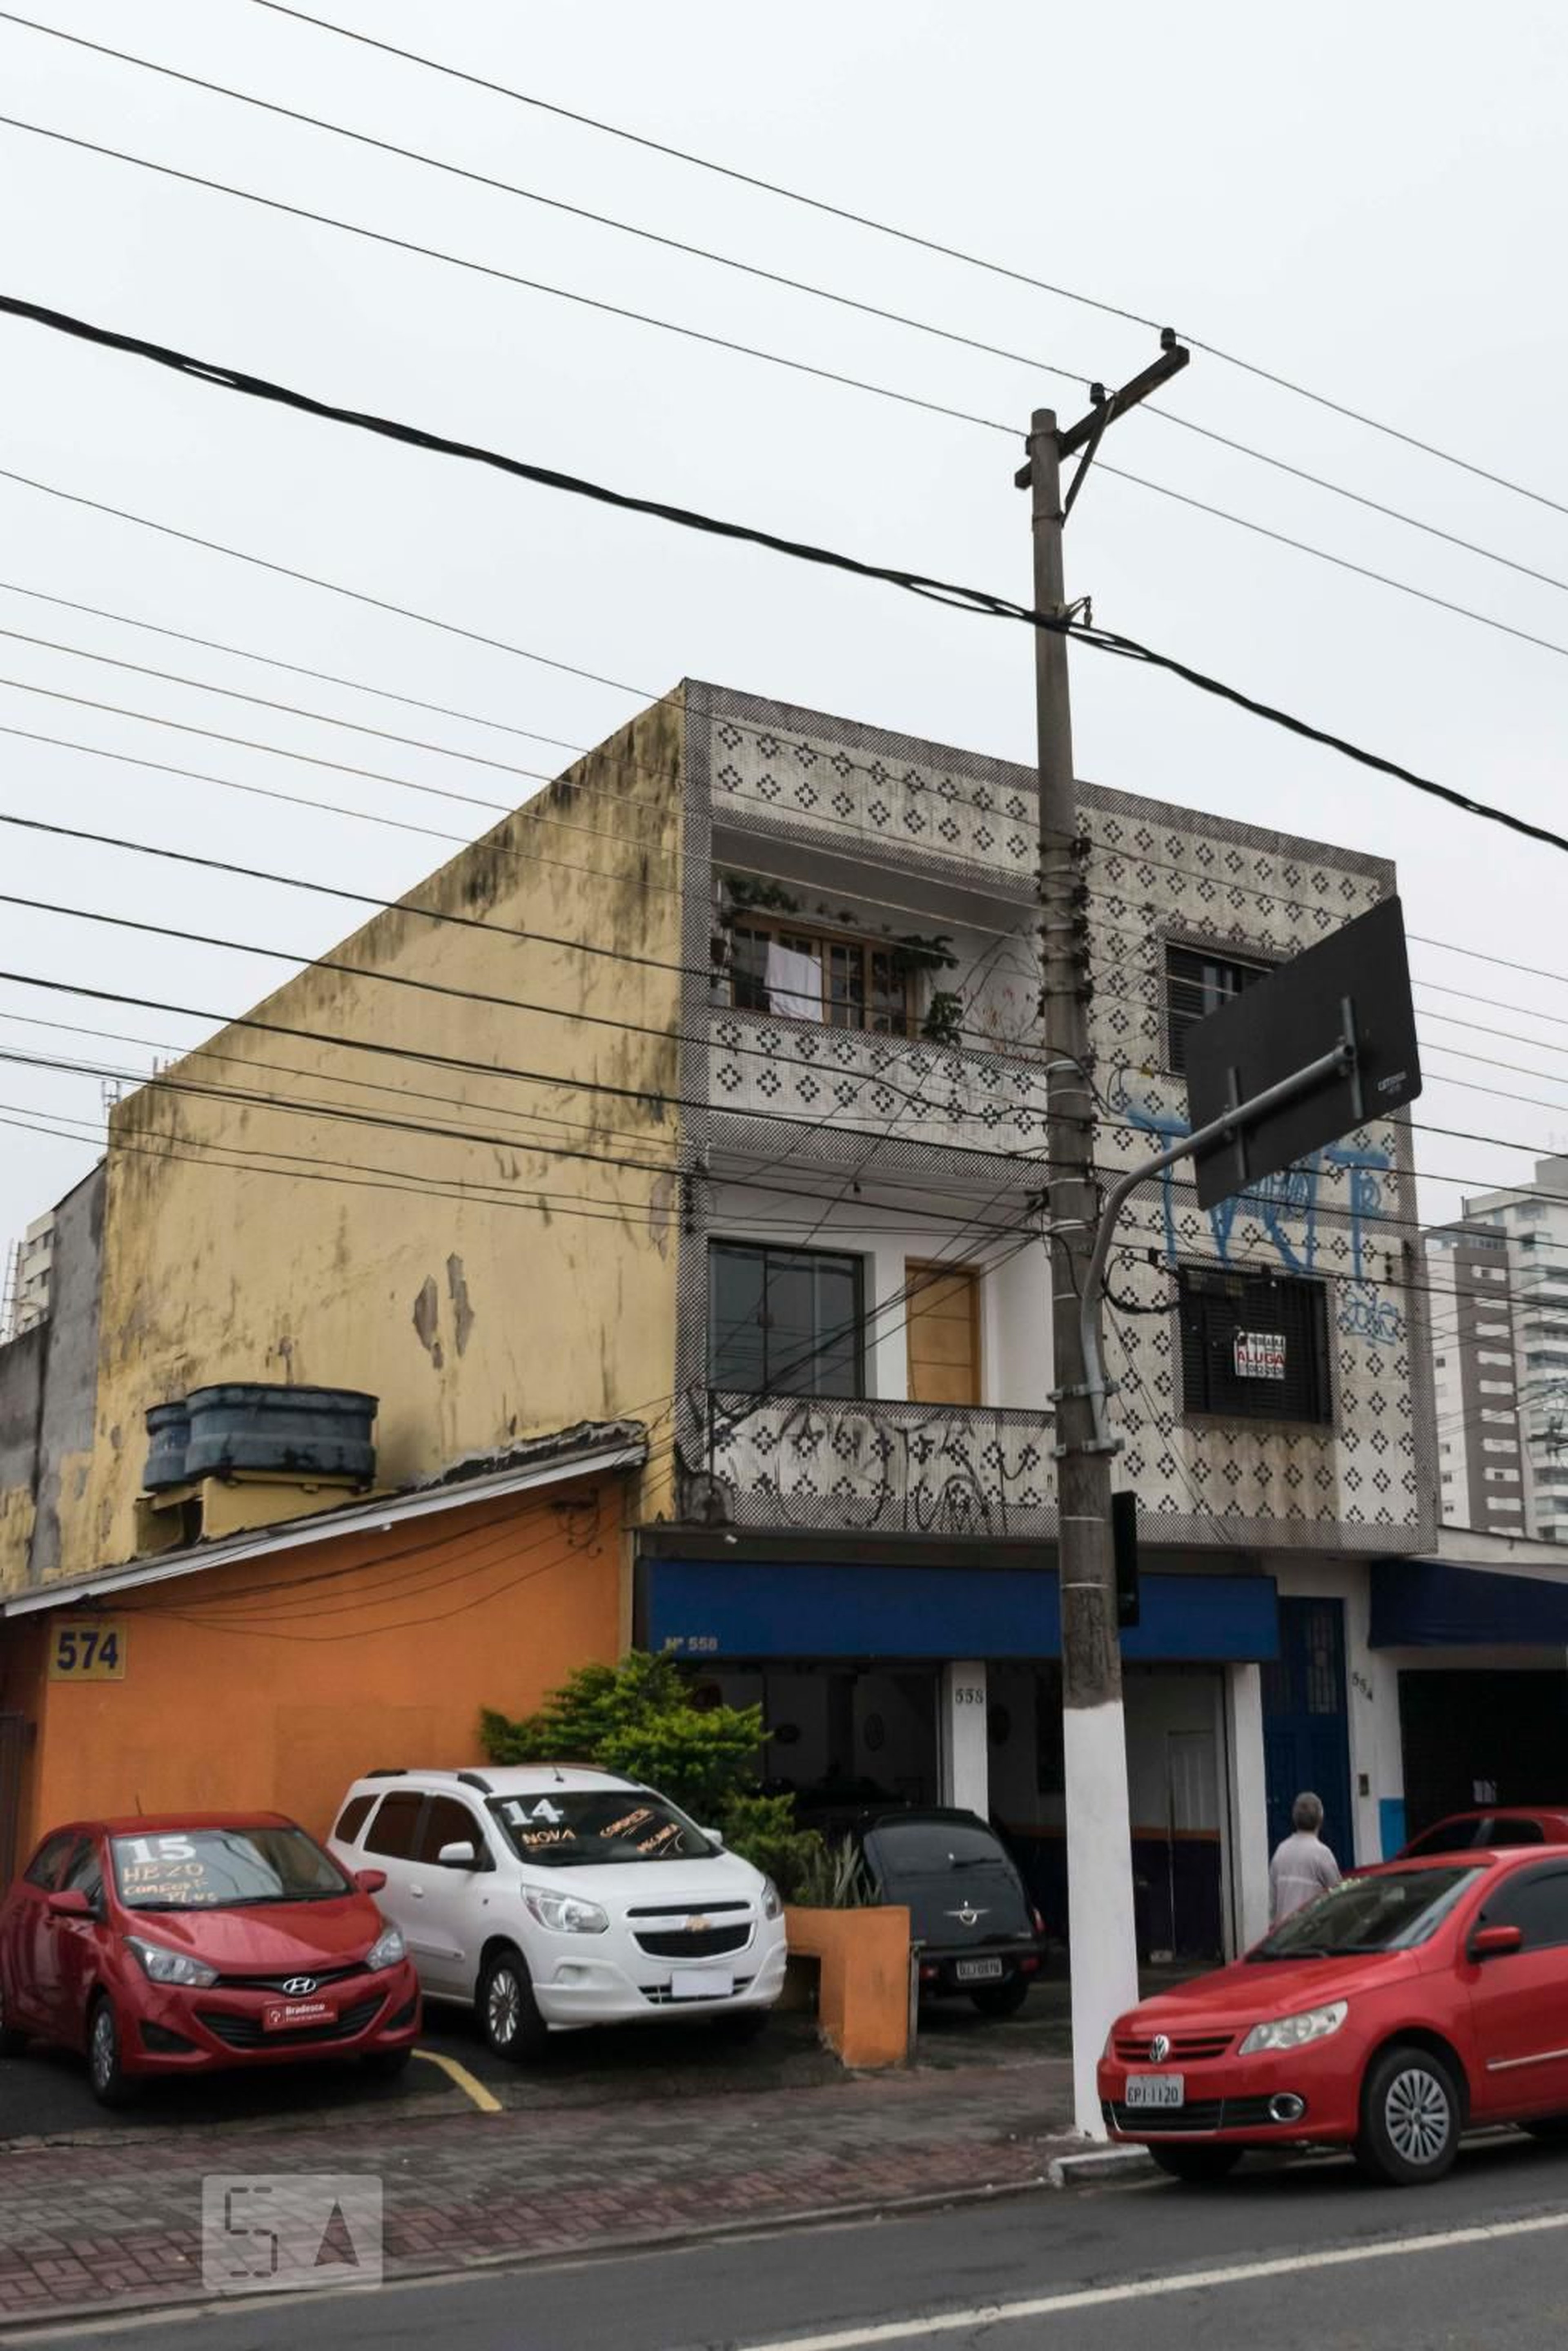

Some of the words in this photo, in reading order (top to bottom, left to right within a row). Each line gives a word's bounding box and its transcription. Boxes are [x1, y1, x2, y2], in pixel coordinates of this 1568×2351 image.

[1238, 1351, 1285, 1363] ALUGA
[58, 1632, 118, 1669] 574
[688, 1637, 717, 1651] 558
[502, 1798, 564, 1825] 14
[522, 1829, 576, 1845] NOVA
[128, 1836, 196, 1863] 15
[286, 2004, 325, 2016] Bradesco
